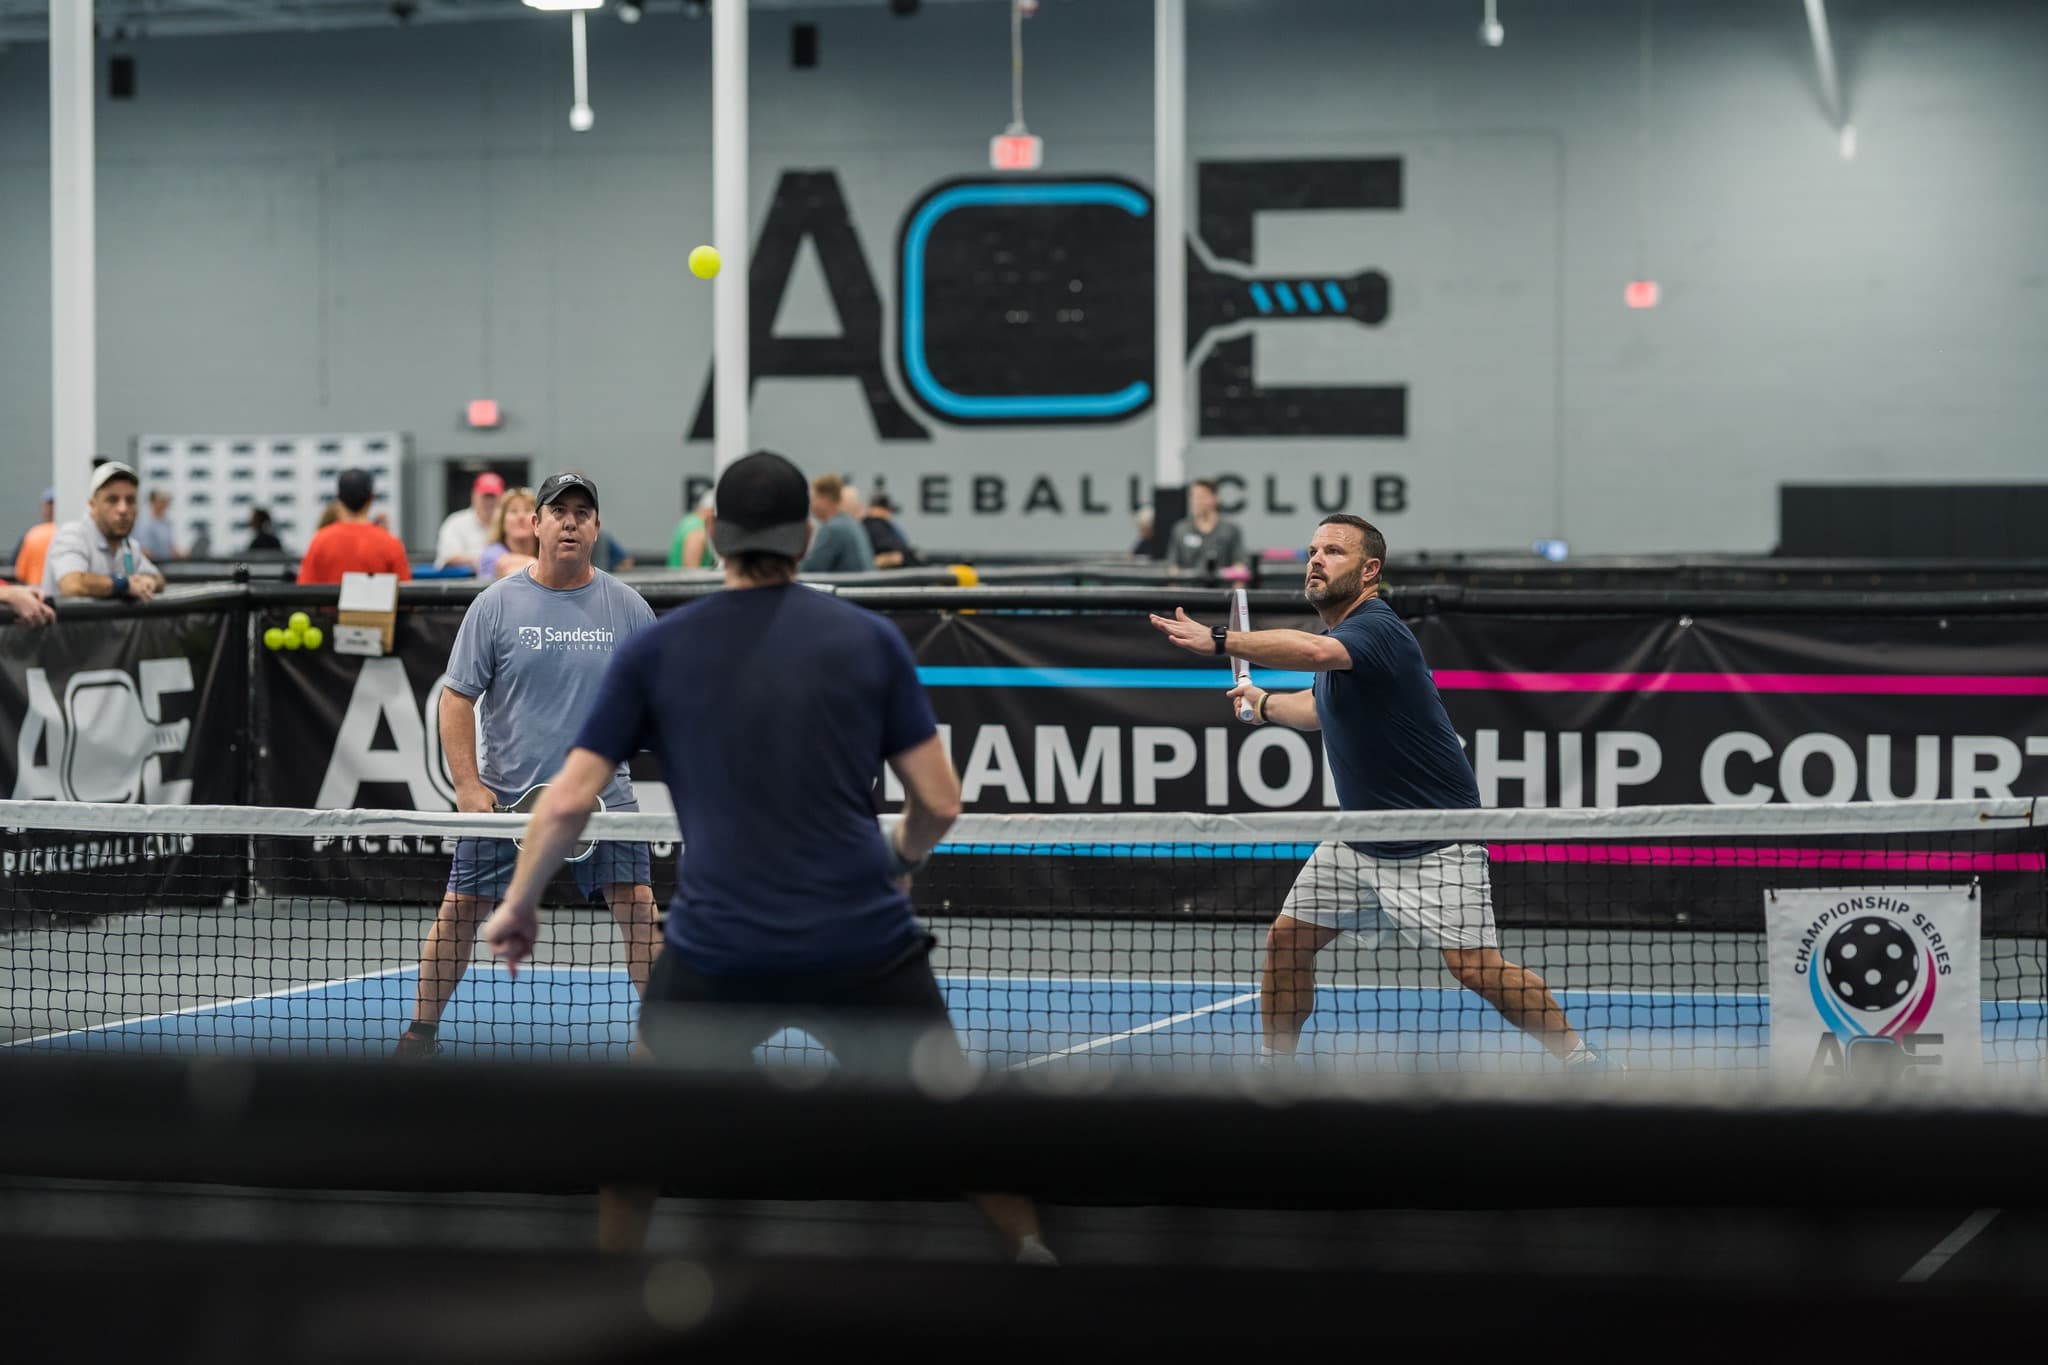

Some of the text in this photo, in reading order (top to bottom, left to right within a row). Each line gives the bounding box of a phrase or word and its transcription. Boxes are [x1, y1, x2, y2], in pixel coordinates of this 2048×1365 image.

[685, 157, 1408, 441] ACE
[1206, 473, 1408, 514] CLUB
[544, 626, 614, 642] Sandestin
[3, 837, 136, 878] PICKLEBALL
[1794, 895, 1952, 977] CHAMPIONSHIP SERIES
